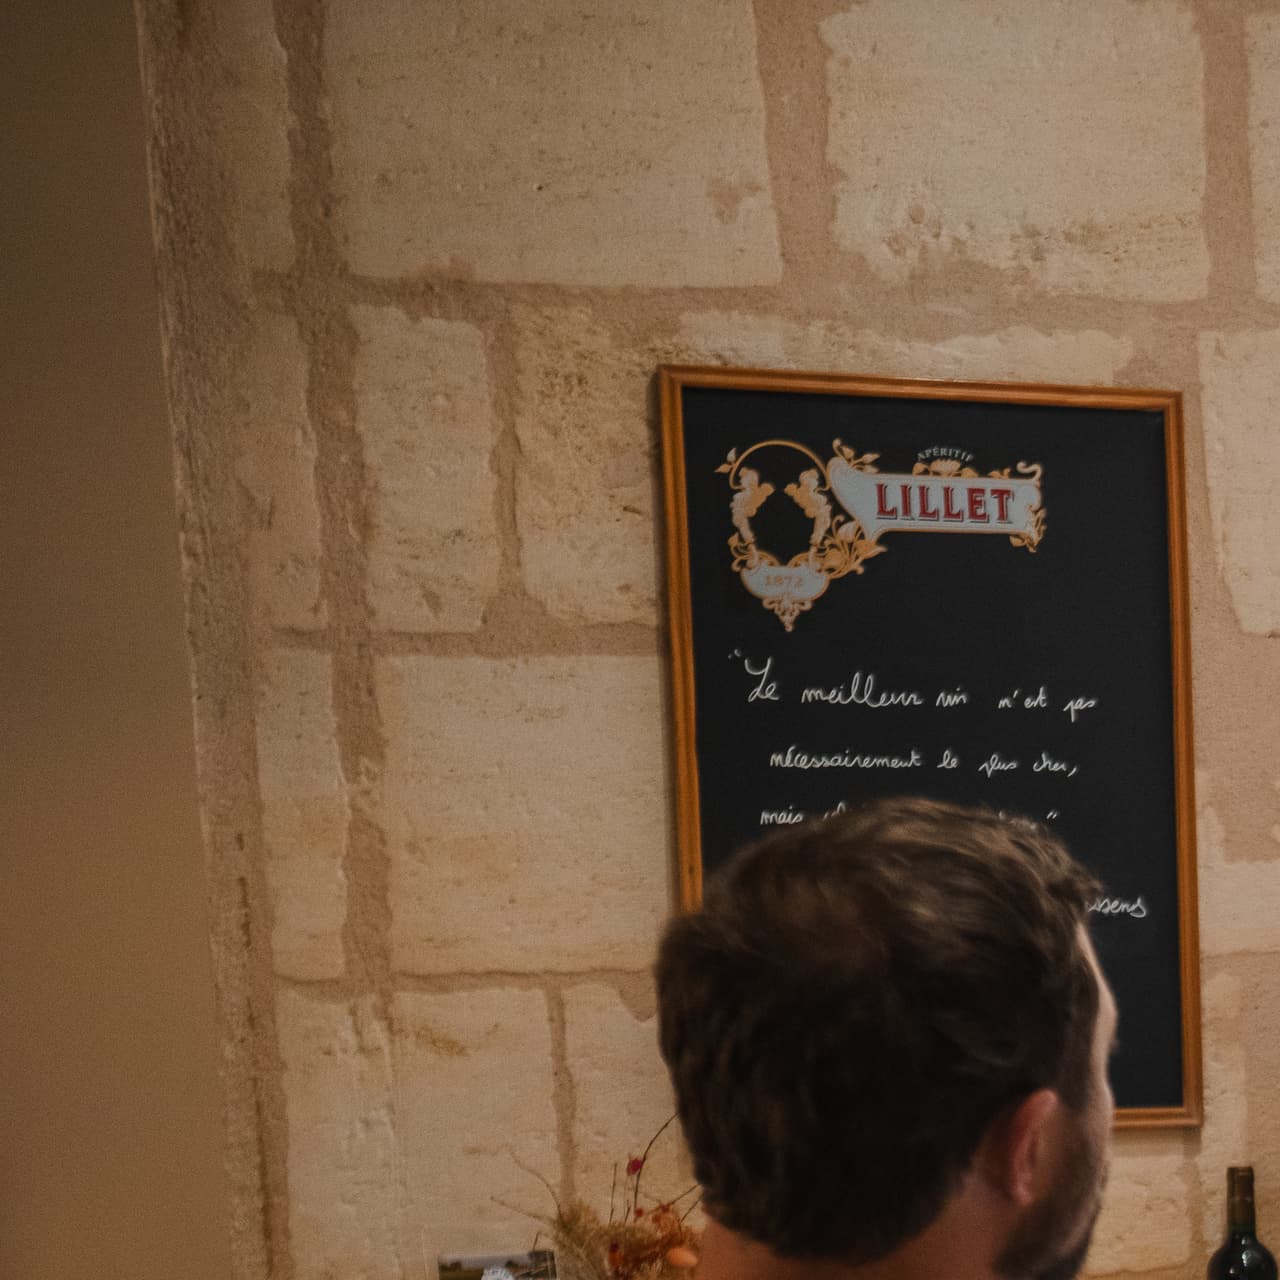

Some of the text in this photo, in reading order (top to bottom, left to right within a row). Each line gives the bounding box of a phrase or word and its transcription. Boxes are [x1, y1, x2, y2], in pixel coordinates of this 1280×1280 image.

[915, 445, 975, 463] APÉRITIF
[875, 482, 1015, 525] LILLET
[801, 671, 923, 708] meilleur
[935, 686, 967, 708] vin
[1063, 697, 1098, 723] pas
[769, 744, 921, 769] nécessairement
[936, 750, 959, 769] le
[977, 754, 1018, 778] plus
[760, 805, 804, 825] mais
